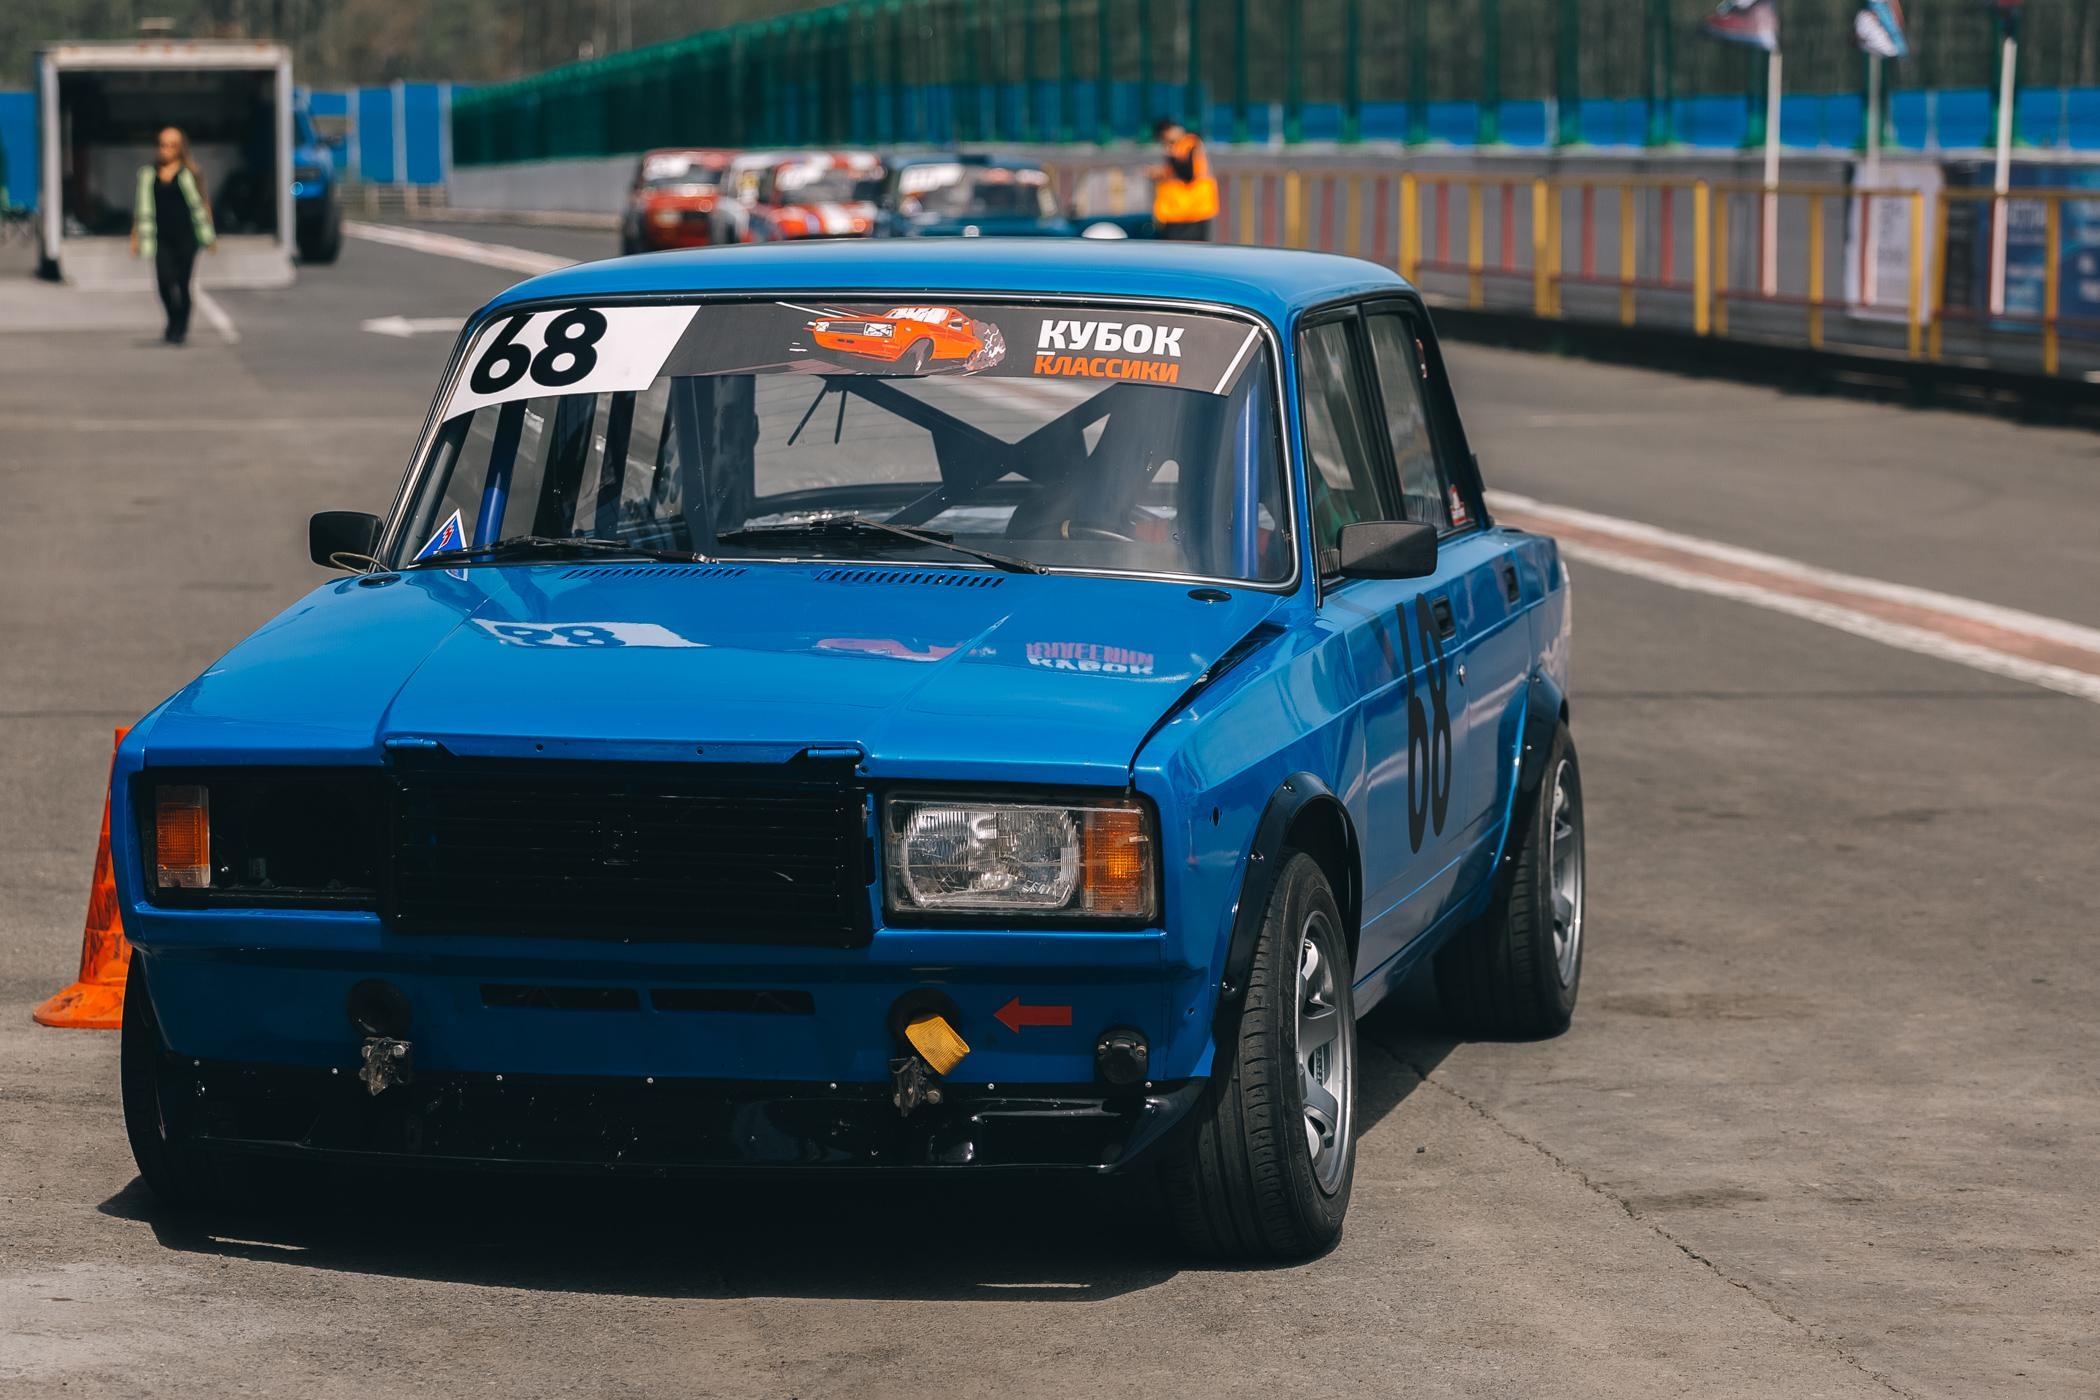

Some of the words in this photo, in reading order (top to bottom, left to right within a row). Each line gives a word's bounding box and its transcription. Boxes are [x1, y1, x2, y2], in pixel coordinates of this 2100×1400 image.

[470, 307, 608, 395] 68
[1033, 354, 1180, 385] КЛАССИКИ
[1037, 319, 1185, 357] КУБОК
[1396, 592, 1452, 855] 68
